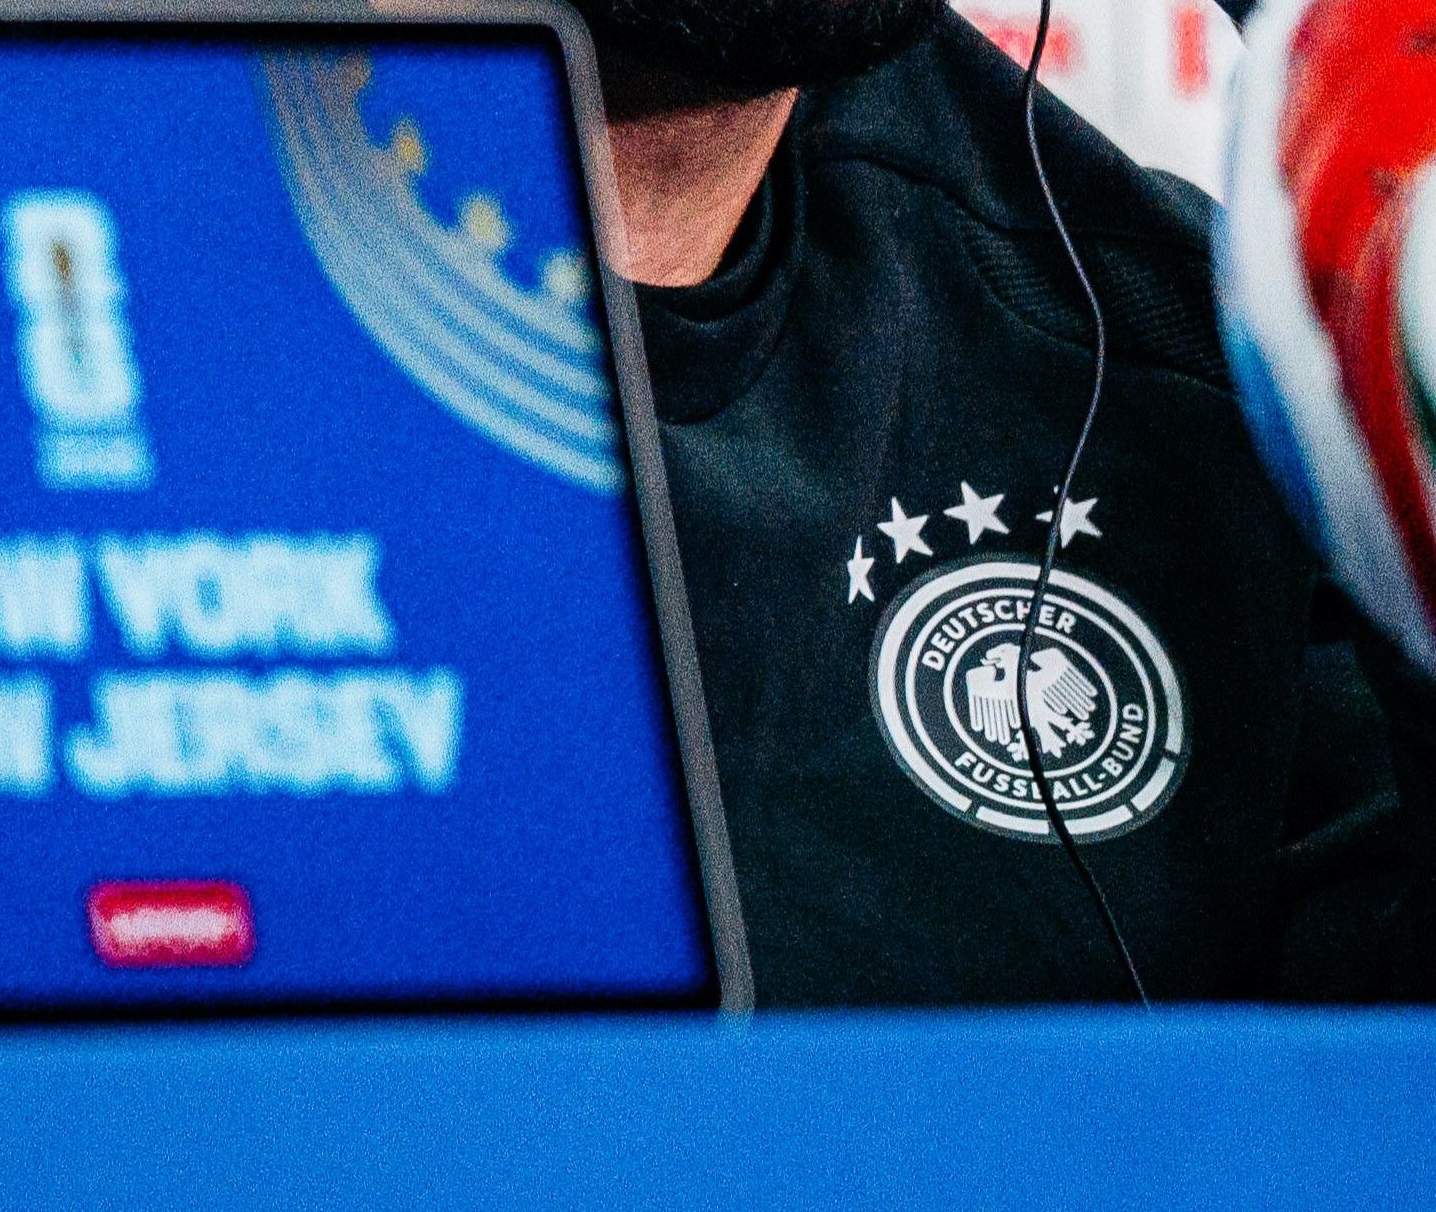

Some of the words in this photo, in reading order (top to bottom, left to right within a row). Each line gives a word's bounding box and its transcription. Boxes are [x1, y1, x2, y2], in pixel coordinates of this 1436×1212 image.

[97, 536, 392, 657] YORK
[921, 599, 1077, 671] DEUTSCHER
[66, 668, 462, 796] JERSEY
